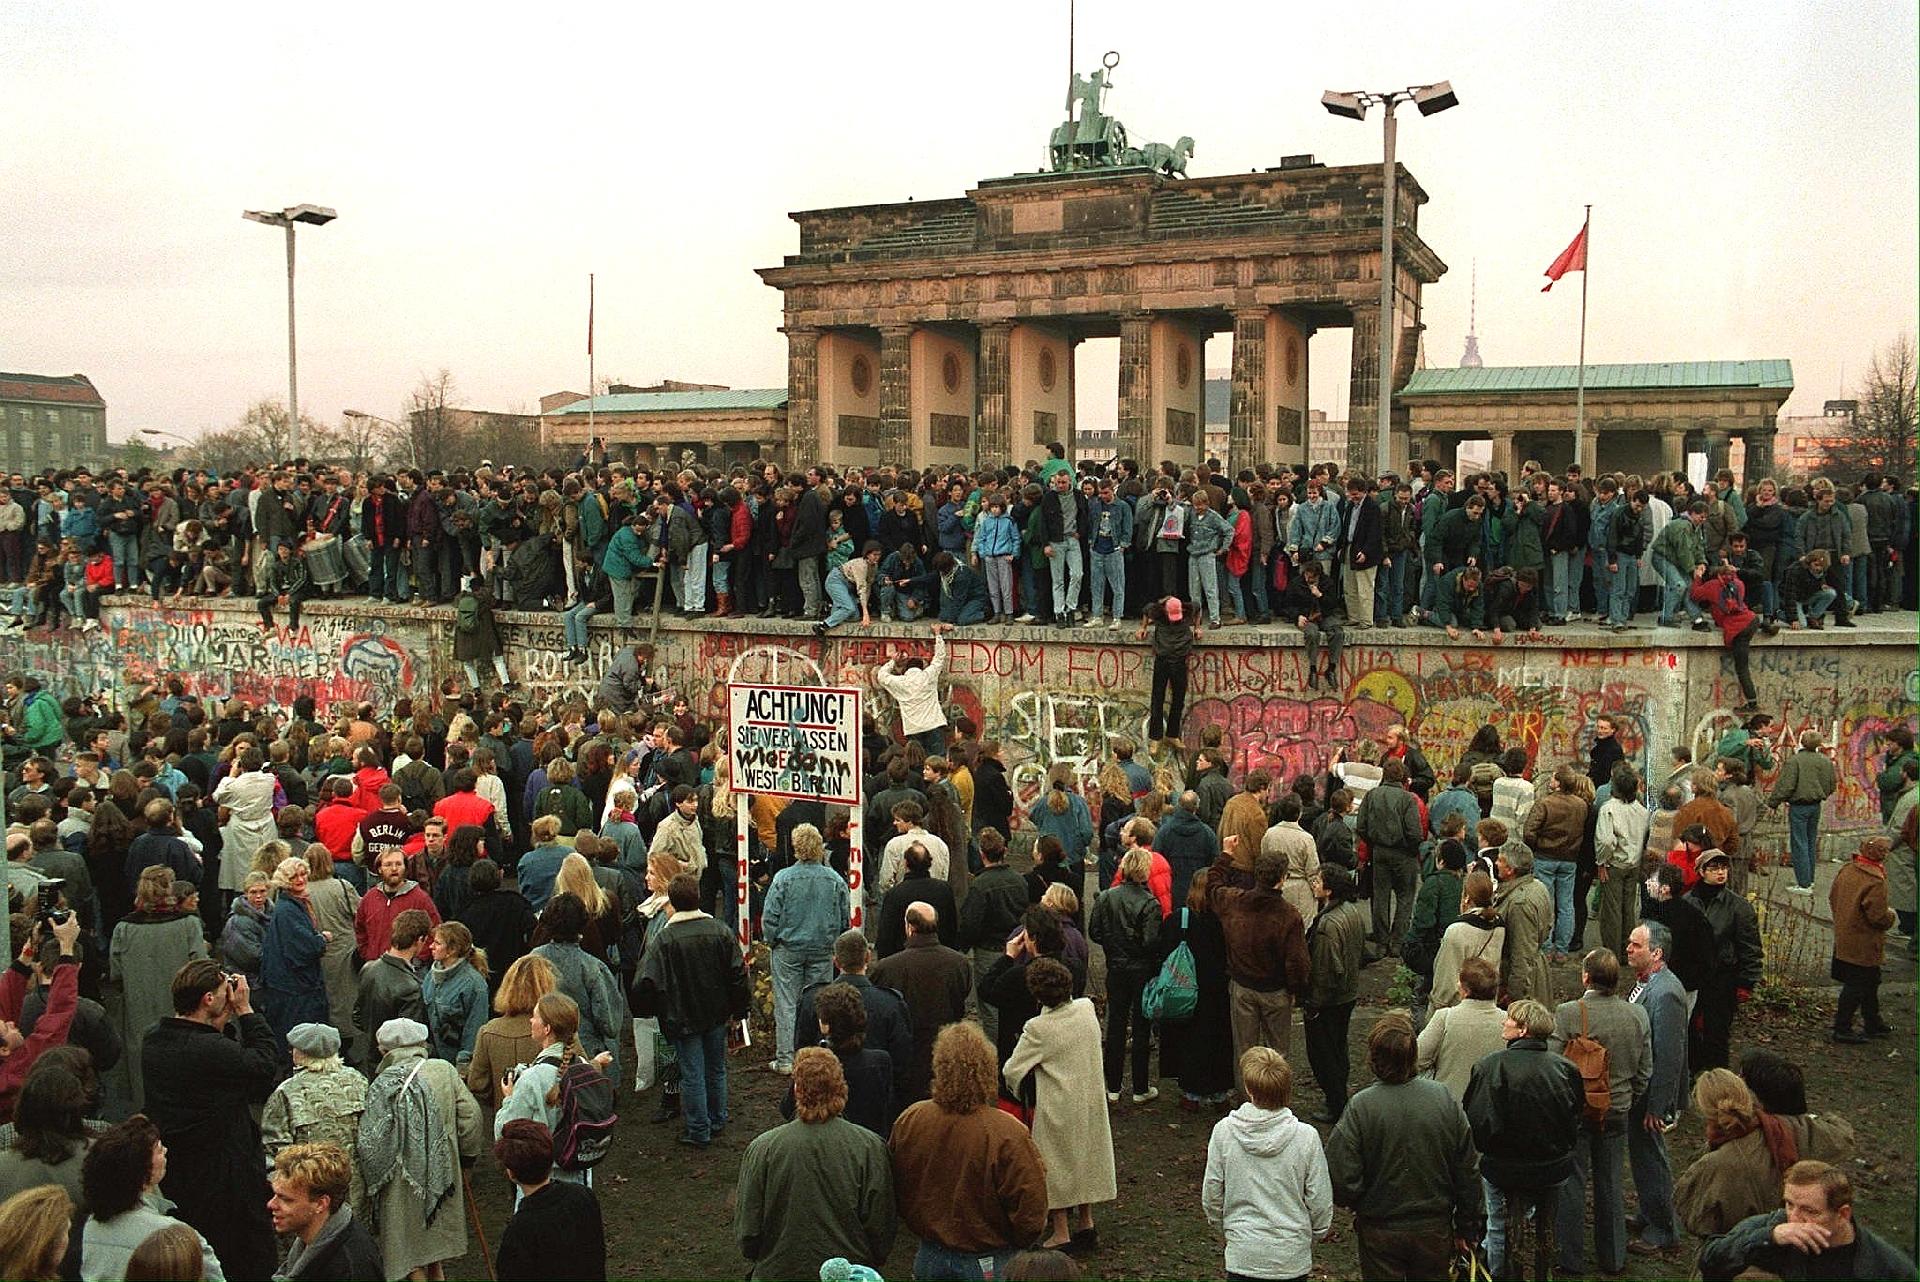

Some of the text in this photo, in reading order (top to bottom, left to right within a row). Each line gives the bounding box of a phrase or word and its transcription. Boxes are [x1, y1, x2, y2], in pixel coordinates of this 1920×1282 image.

[1067, 645, 1143, 689] FOR
[745, 689, 845, 725] ACHTUNG!
[737, 725, 848, 752] SIE VERLASSEN
[744, 768, 842, 796] WEST BERLIN
[368, 823, 406, 839] BERLIN
